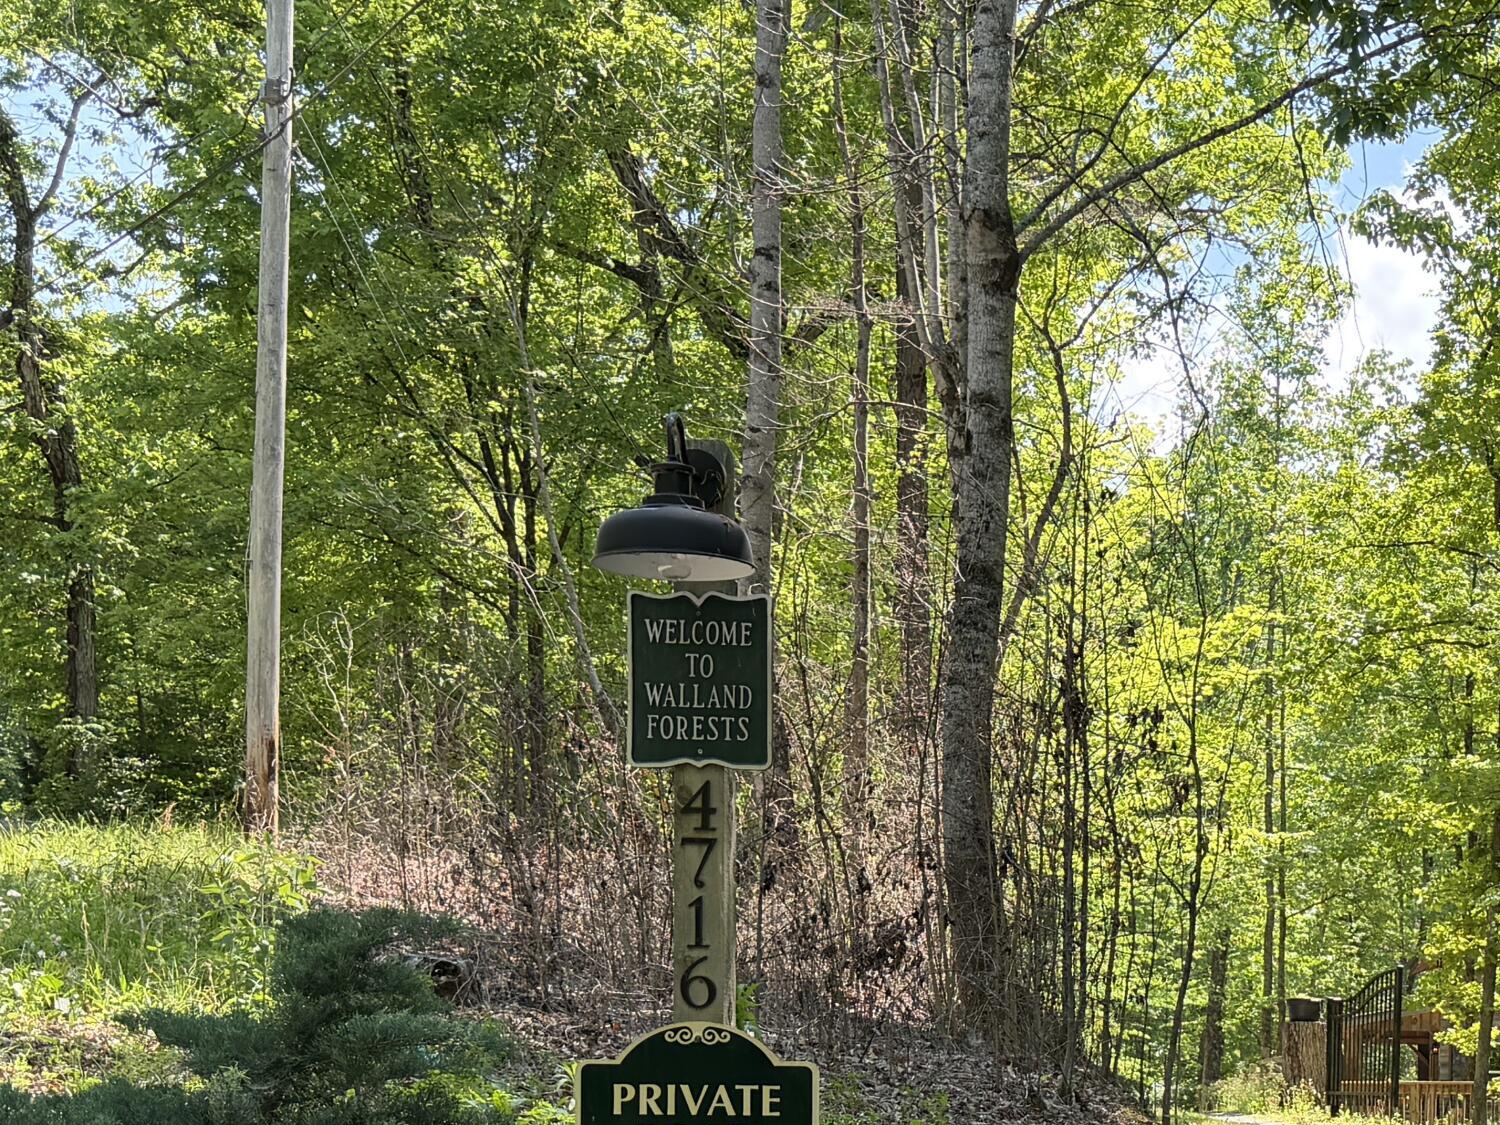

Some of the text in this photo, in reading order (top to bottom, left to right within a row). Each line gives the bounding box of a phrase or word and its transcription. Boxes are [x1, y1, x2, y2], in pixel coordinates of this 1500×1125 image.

[644, 618, 752, 647] WELCOME
[685, 653, 714, 678] TO
[644, 682, 752, 710] WALLAND
[647, 714, 749, 741] FORESTS
[680, 780, 718, 1010] 4716
[612, 1083, 781, 1117] PRIVATE
